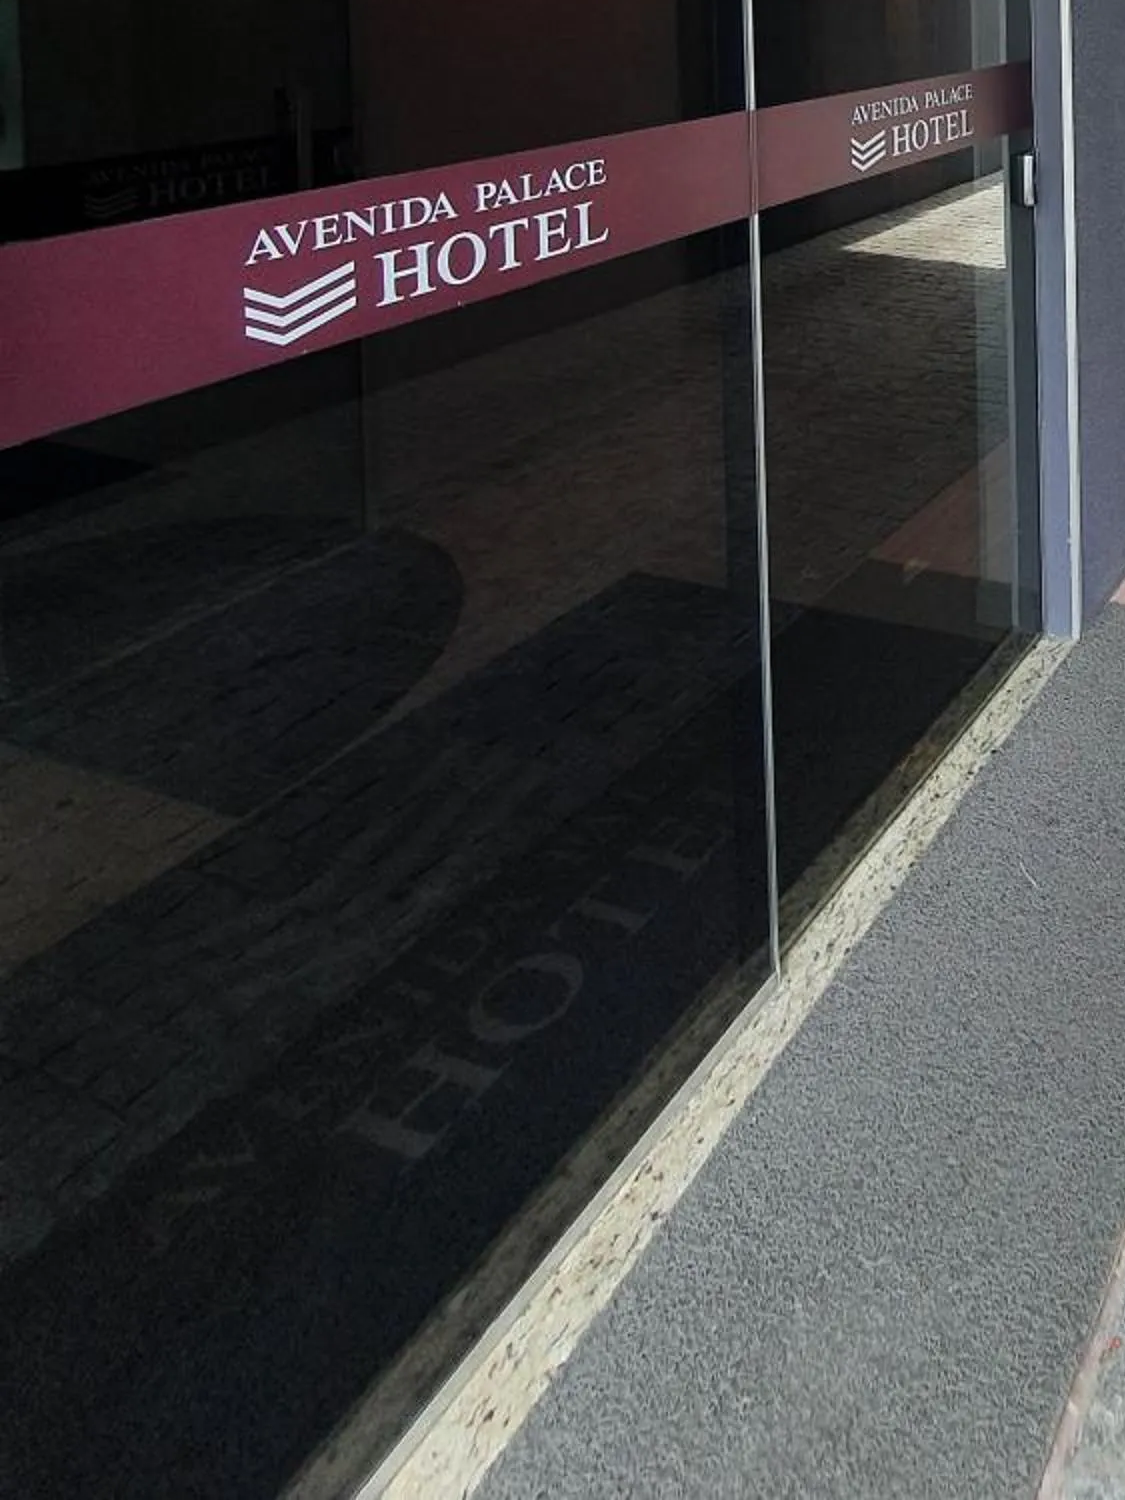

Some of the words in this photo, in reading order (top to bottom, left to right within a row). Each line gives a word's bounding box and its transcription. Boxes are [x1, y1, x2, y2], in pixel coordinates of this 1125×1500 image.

[851, 94, 918, 125] AVENIDA
[925, 83, 973, 109] PALACE
[892, 109, 974, 157] HOTEL
[244, 191, 459, 266] AVENIDA
[475, 158, 607, 212] PALACE
[373, 201, 609, 307] HOTEL
